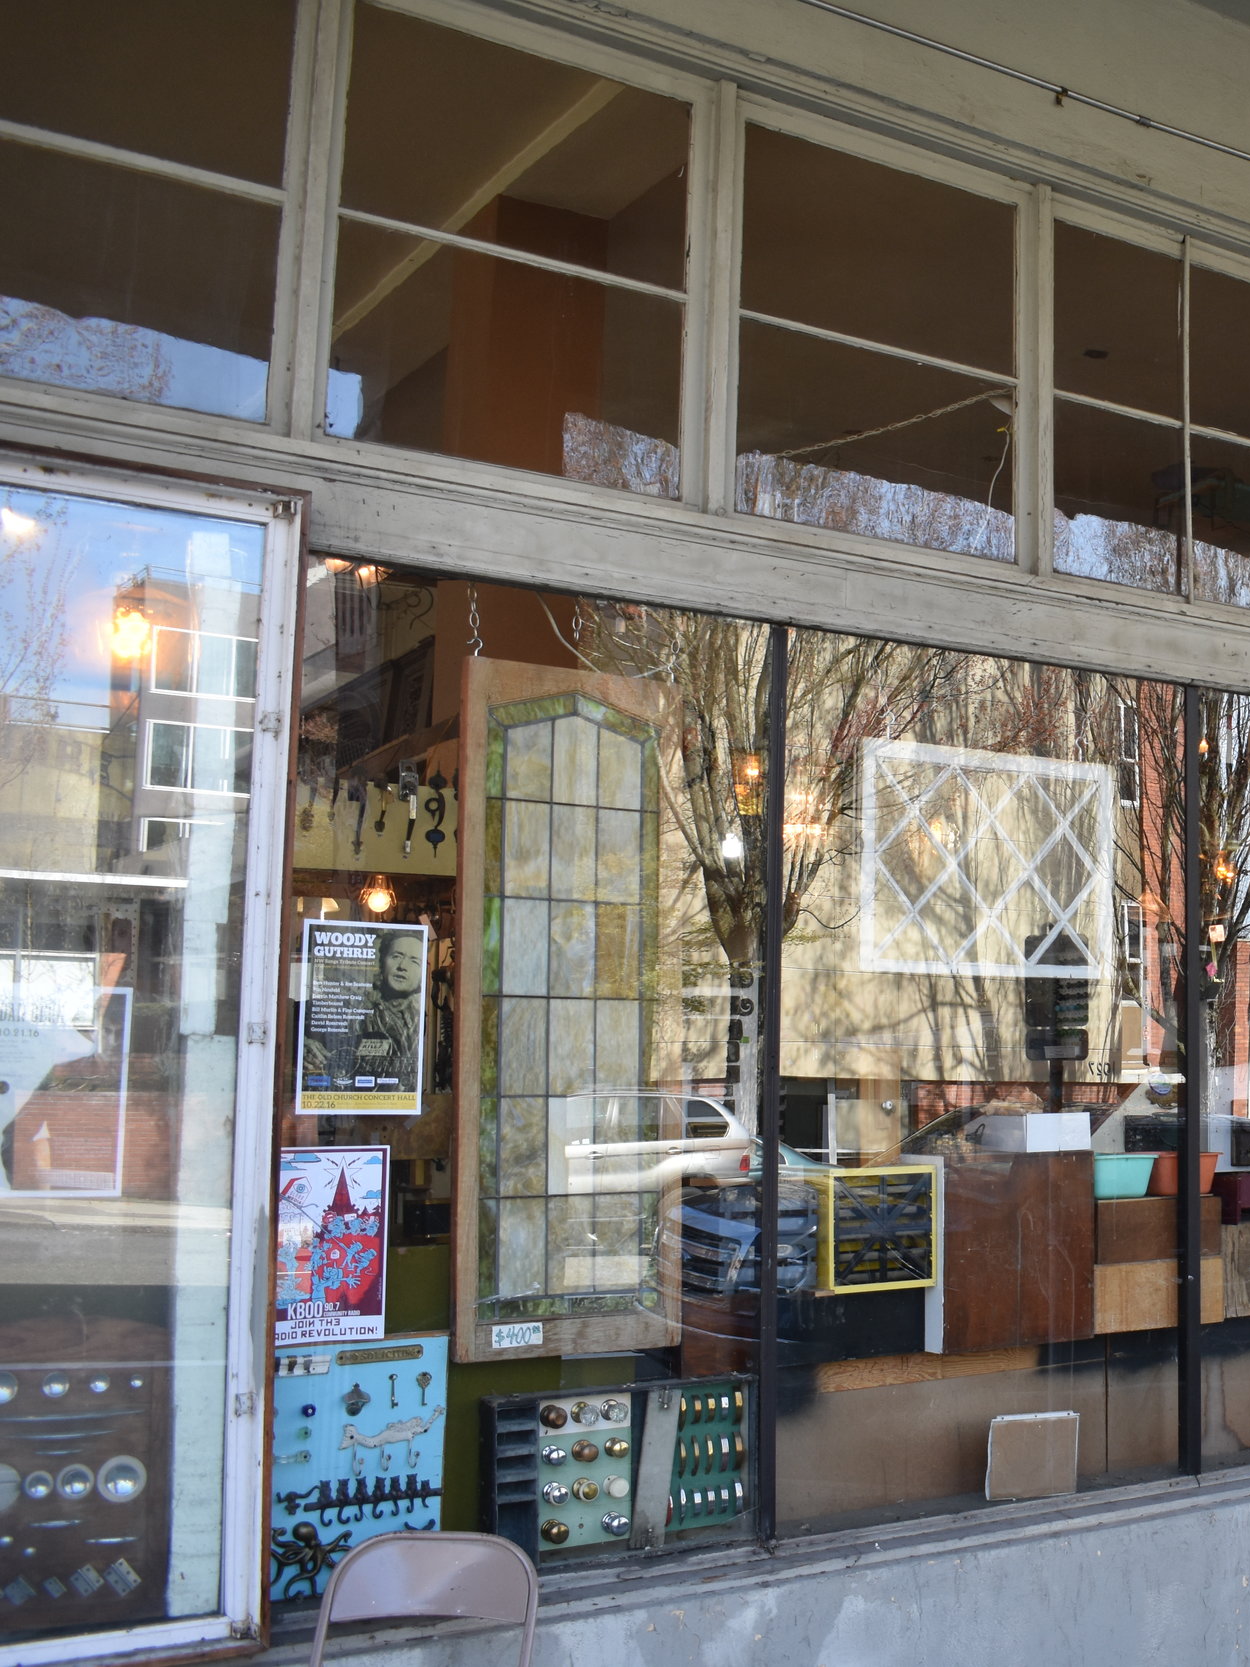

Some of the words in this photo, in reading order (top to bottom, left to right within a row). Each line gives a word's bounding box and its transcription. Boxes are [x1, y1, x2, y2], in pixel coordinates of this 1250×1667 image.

[314, 931, 377, 947] WOODY
[314, 946, 376, 959] GUTHRIE
[302, 1101, 336, 1109] 10.22.16
[287, 1301, 323, 1320] KBOO
[324, 1302, 340, 1311] 90.7
[275, 1331, 298, 1341] ADIO
[300, 1326, 378, 1338] REVOLUTION!
[360, 1349, 415, 1360] SOLICITING
